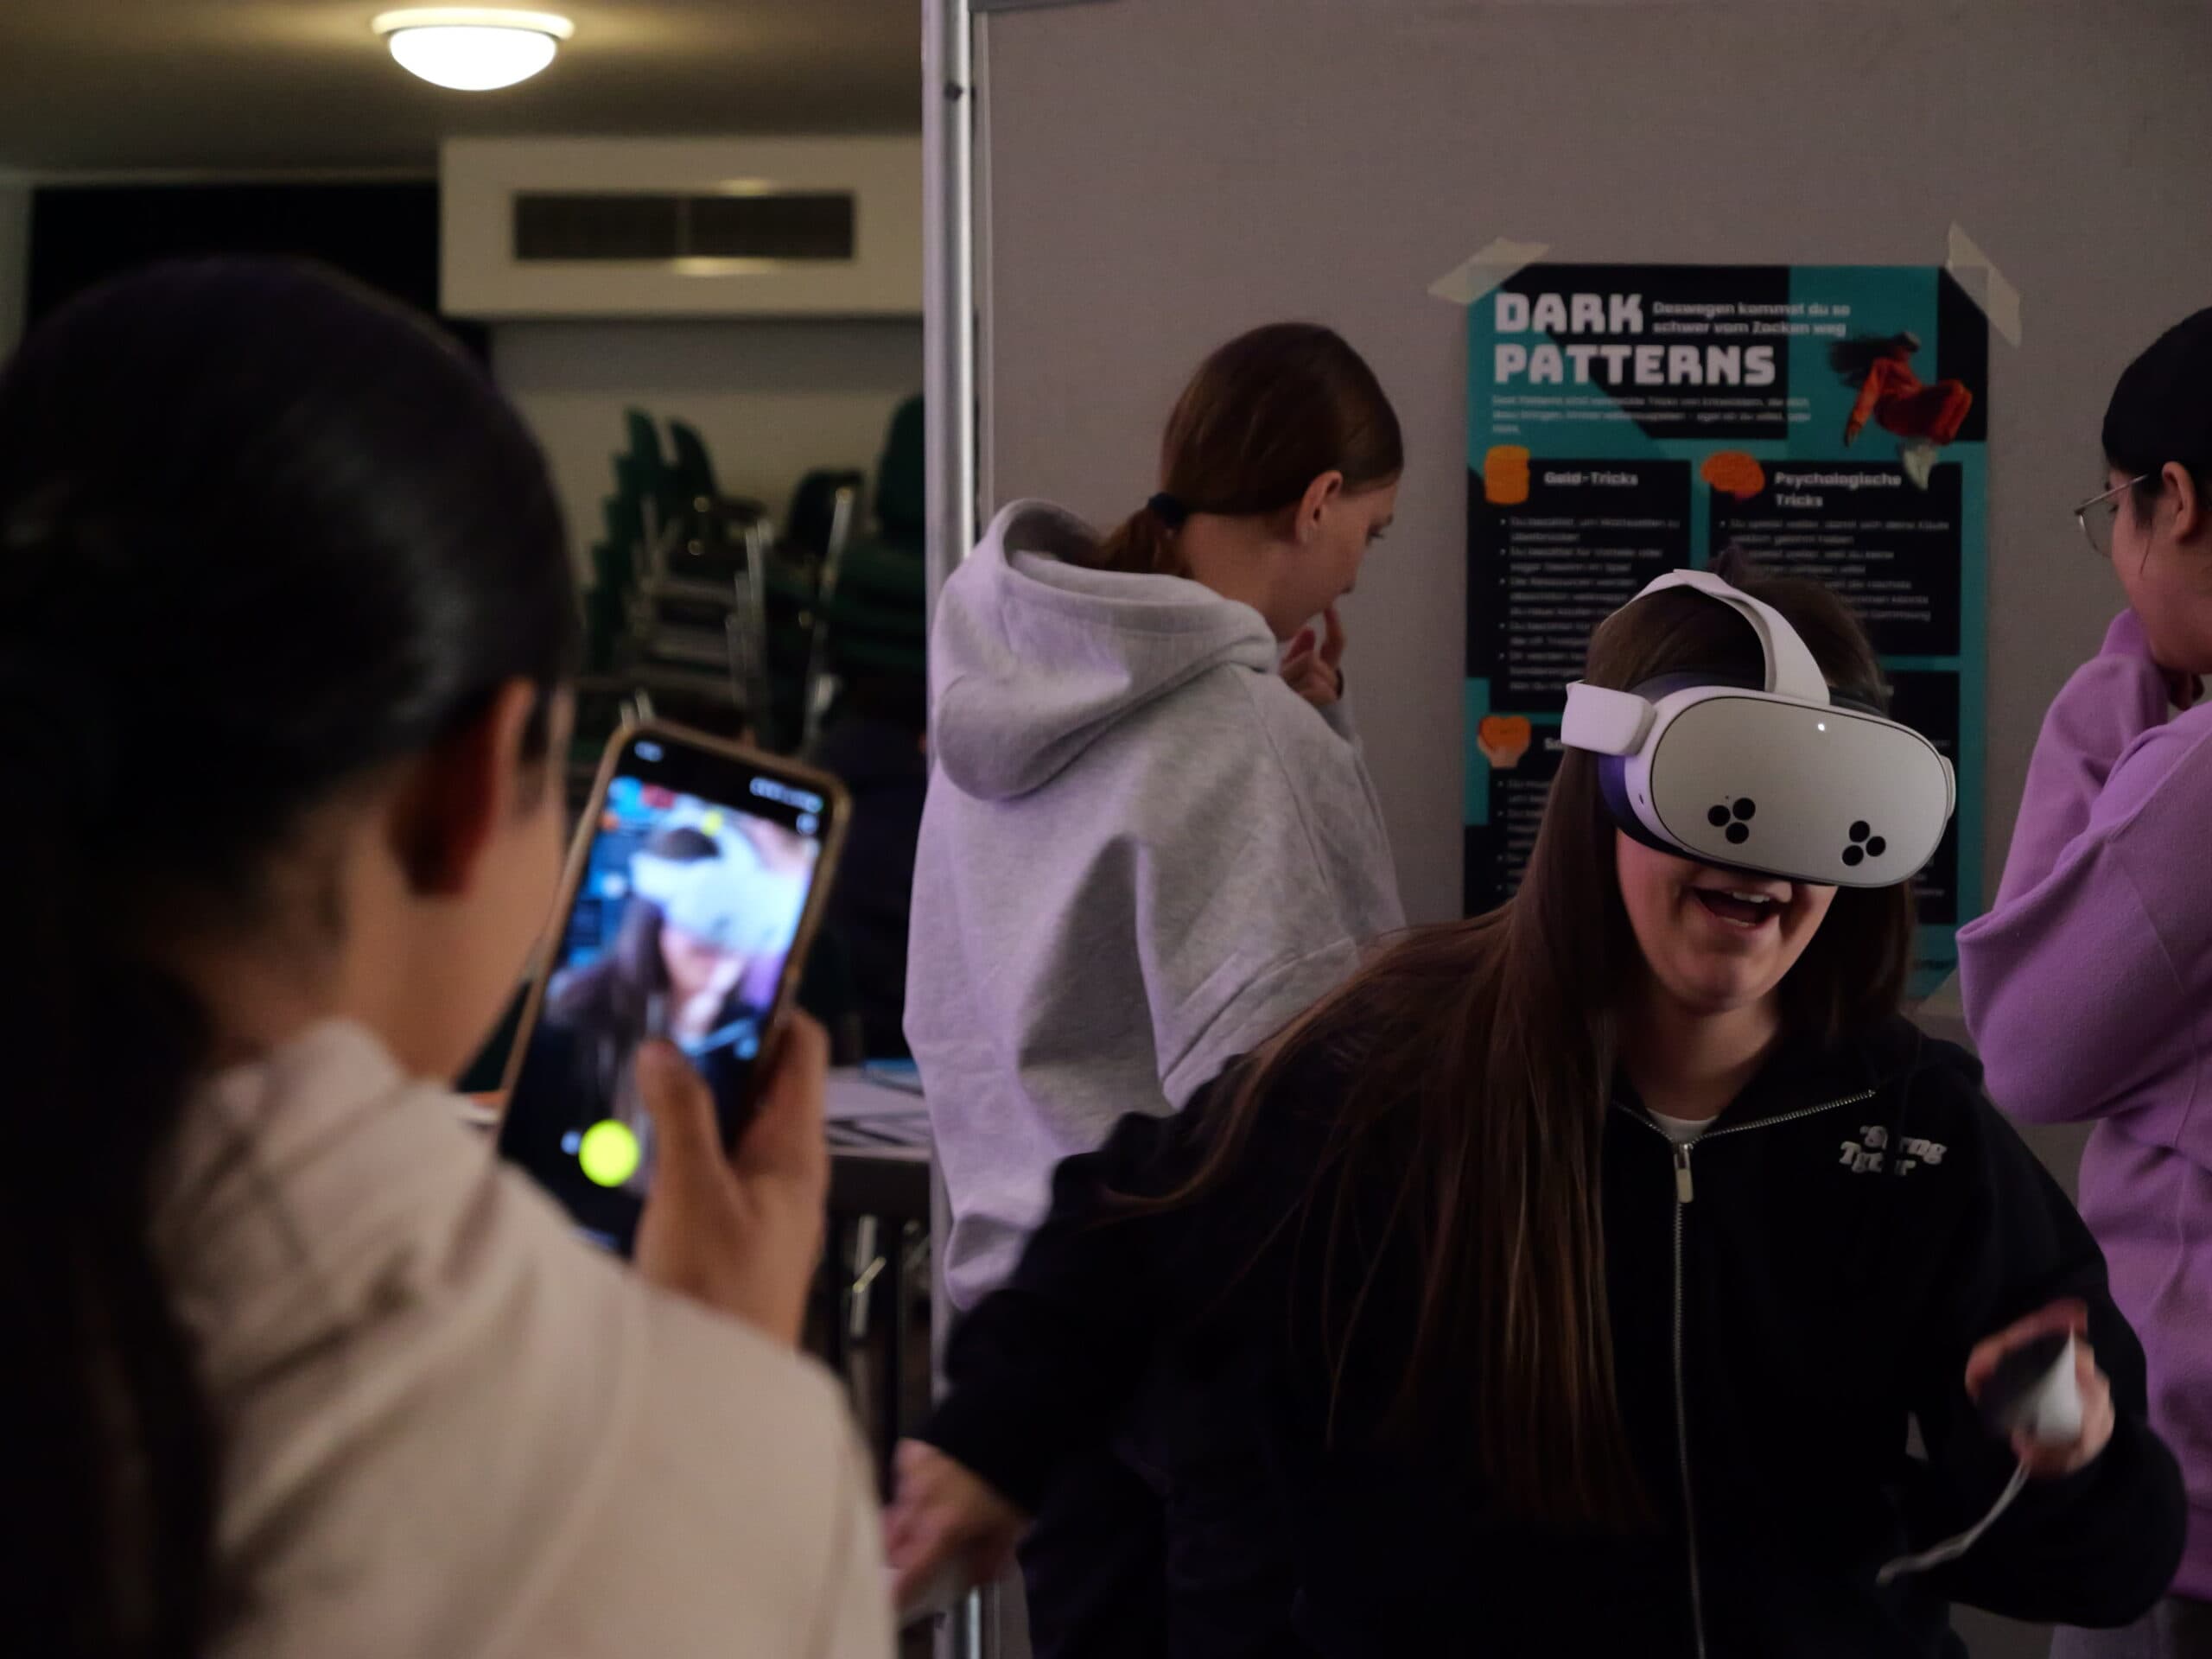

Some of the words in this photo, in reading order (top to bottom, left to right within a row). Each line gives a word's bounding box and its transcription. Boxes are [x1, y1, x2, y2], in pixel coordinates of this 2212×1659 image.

[1495, 293, 1643, 334] DARK
[1653, 302, 1734, 319] Deswegen
[1738, 302, 1803, 316] kommst
[1808, 303, 1828, 316] du
[1833, 305, 1851, 317] so
[1652, 321, 1709, 334] schwer
[1713, 323, 1748, 334] vom
[1752, 321, 1809, 335] Zocken
[1813, 323, 1847, 337] weg
[1495, 345, 1775, 385] PATTERNS
[1544, 471, 1638, 486] Geld-Tricks
[1776, 472, 1902, 490] Psychologische
[1776, 493, 1823, 508] Tricks
